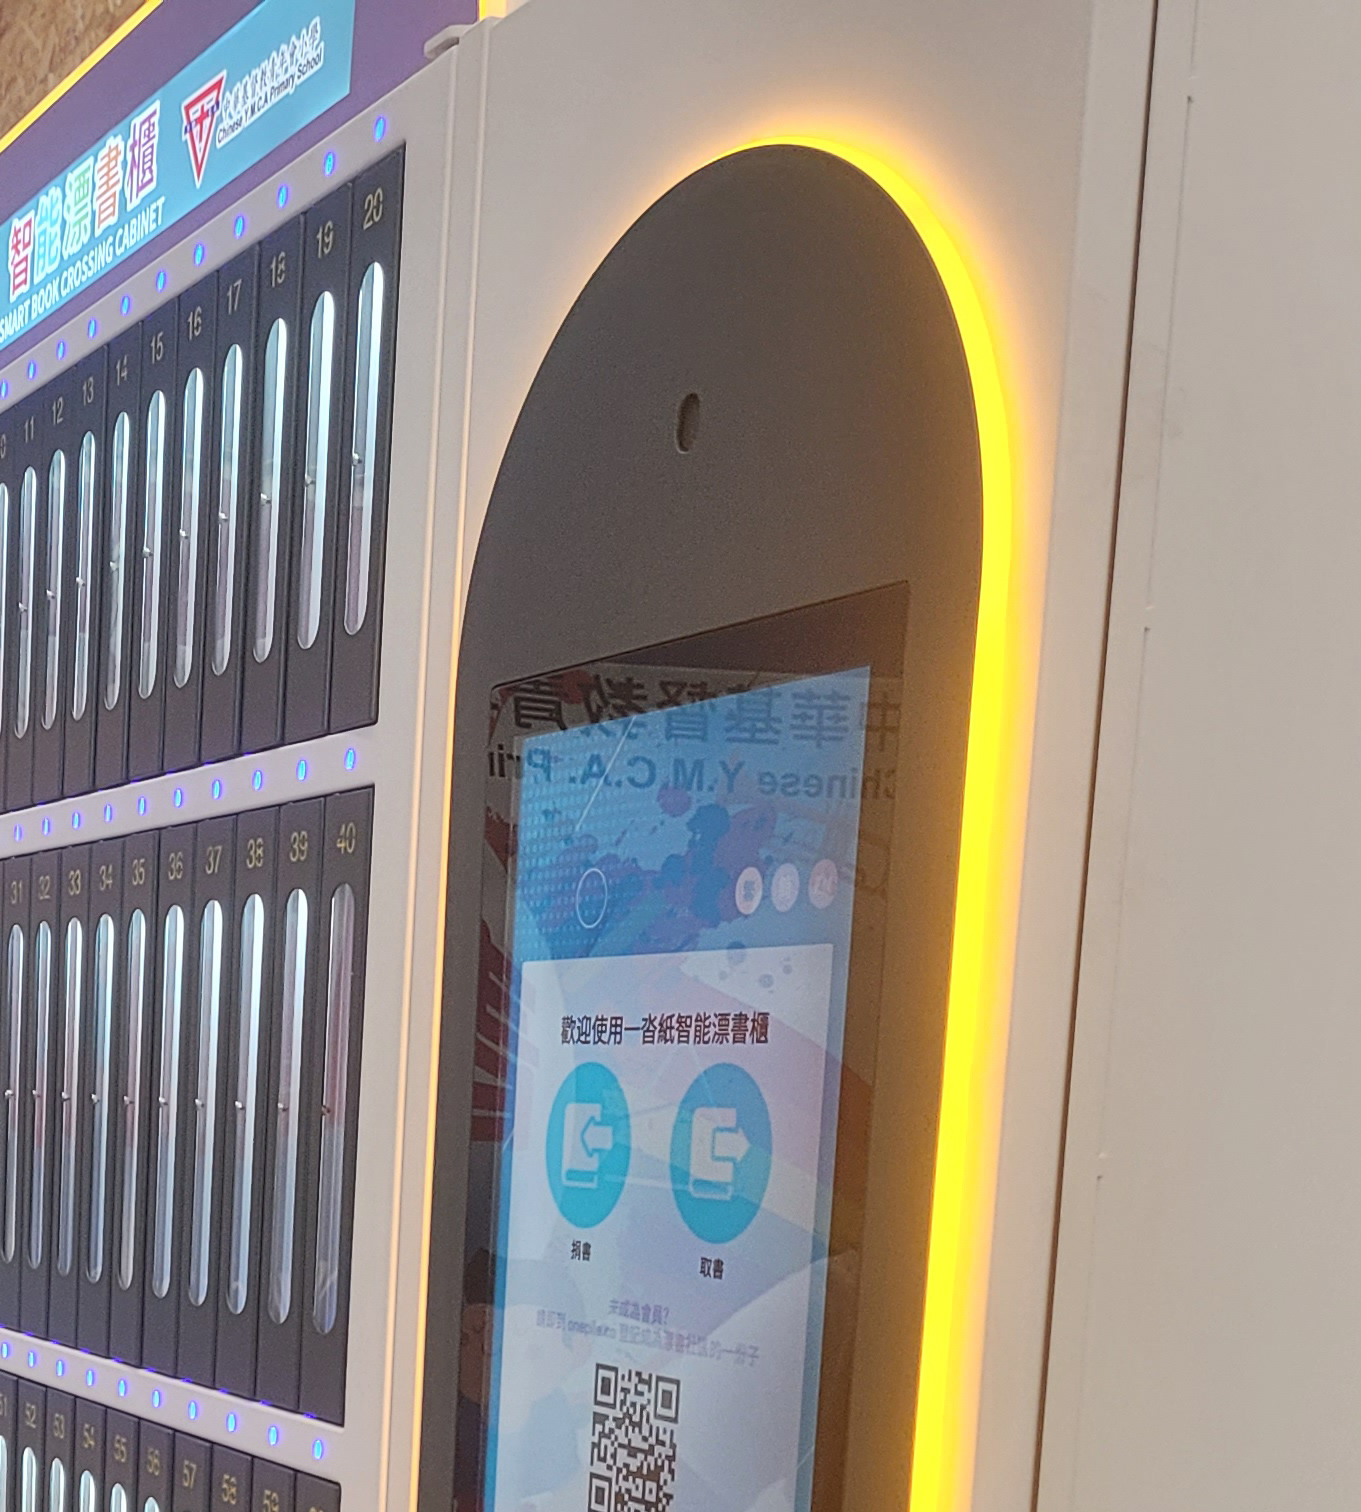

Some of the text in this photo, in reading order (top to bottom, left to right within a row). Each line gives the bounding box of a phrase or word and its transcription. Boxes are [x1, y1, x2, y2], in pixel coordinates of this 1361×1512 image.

[297, 44, 322, 79] School
[9, 101, 159, 301] 智能漂書櫃
[362, 187, 383, 230] 20
[316, 220, 334, 258] 19
[31, 281, 60, 315] BOOK
[60, 238, 113, 295] CROSSING
[115, 196, 165, 256] CABINET
[270, 252, 286, 288] 18
[226, 278, 242, 316] 17
[187, 306, 202, 340] 16
[150, 332, 164, 364] 15
[116, 354, 128, 386] 14
[82, 376, 94, 406] 13
[52, 396, 64, 426] 12
[24, 416, 34, 443] 11
[246, 837, 264, 868] 38
[290, 830, 308, 862] 39
[336, 822, 356, 854] 40
[132, 858, 146, 886] 35
[168, 852, 184, 880] 36
[206, 846, 222, 874] 37
[10, 880, 22, 904] 31
[39, 874, 51, 900] 32
[68, 868, 81, 896] 33
[99, 864, 113, 892] 34
[560, 1011, 770, 1046] 歡迎使用一沓紙智能漂書櫃
[571, 1239, 592, 1262] 捐書
[699, 1256, 724, 1280] 取書
[24, 1402, 36, 1429] 52
[54, 1412, 65, 1440] 53
[82, 1424, 96, 1450] 54
[114, 1434, 128, 1462] 55
[146, 1446, 160, 1476] 56
[182, 1460, 197, 1489] 57
[221, 1474, 238, 1505] 58
